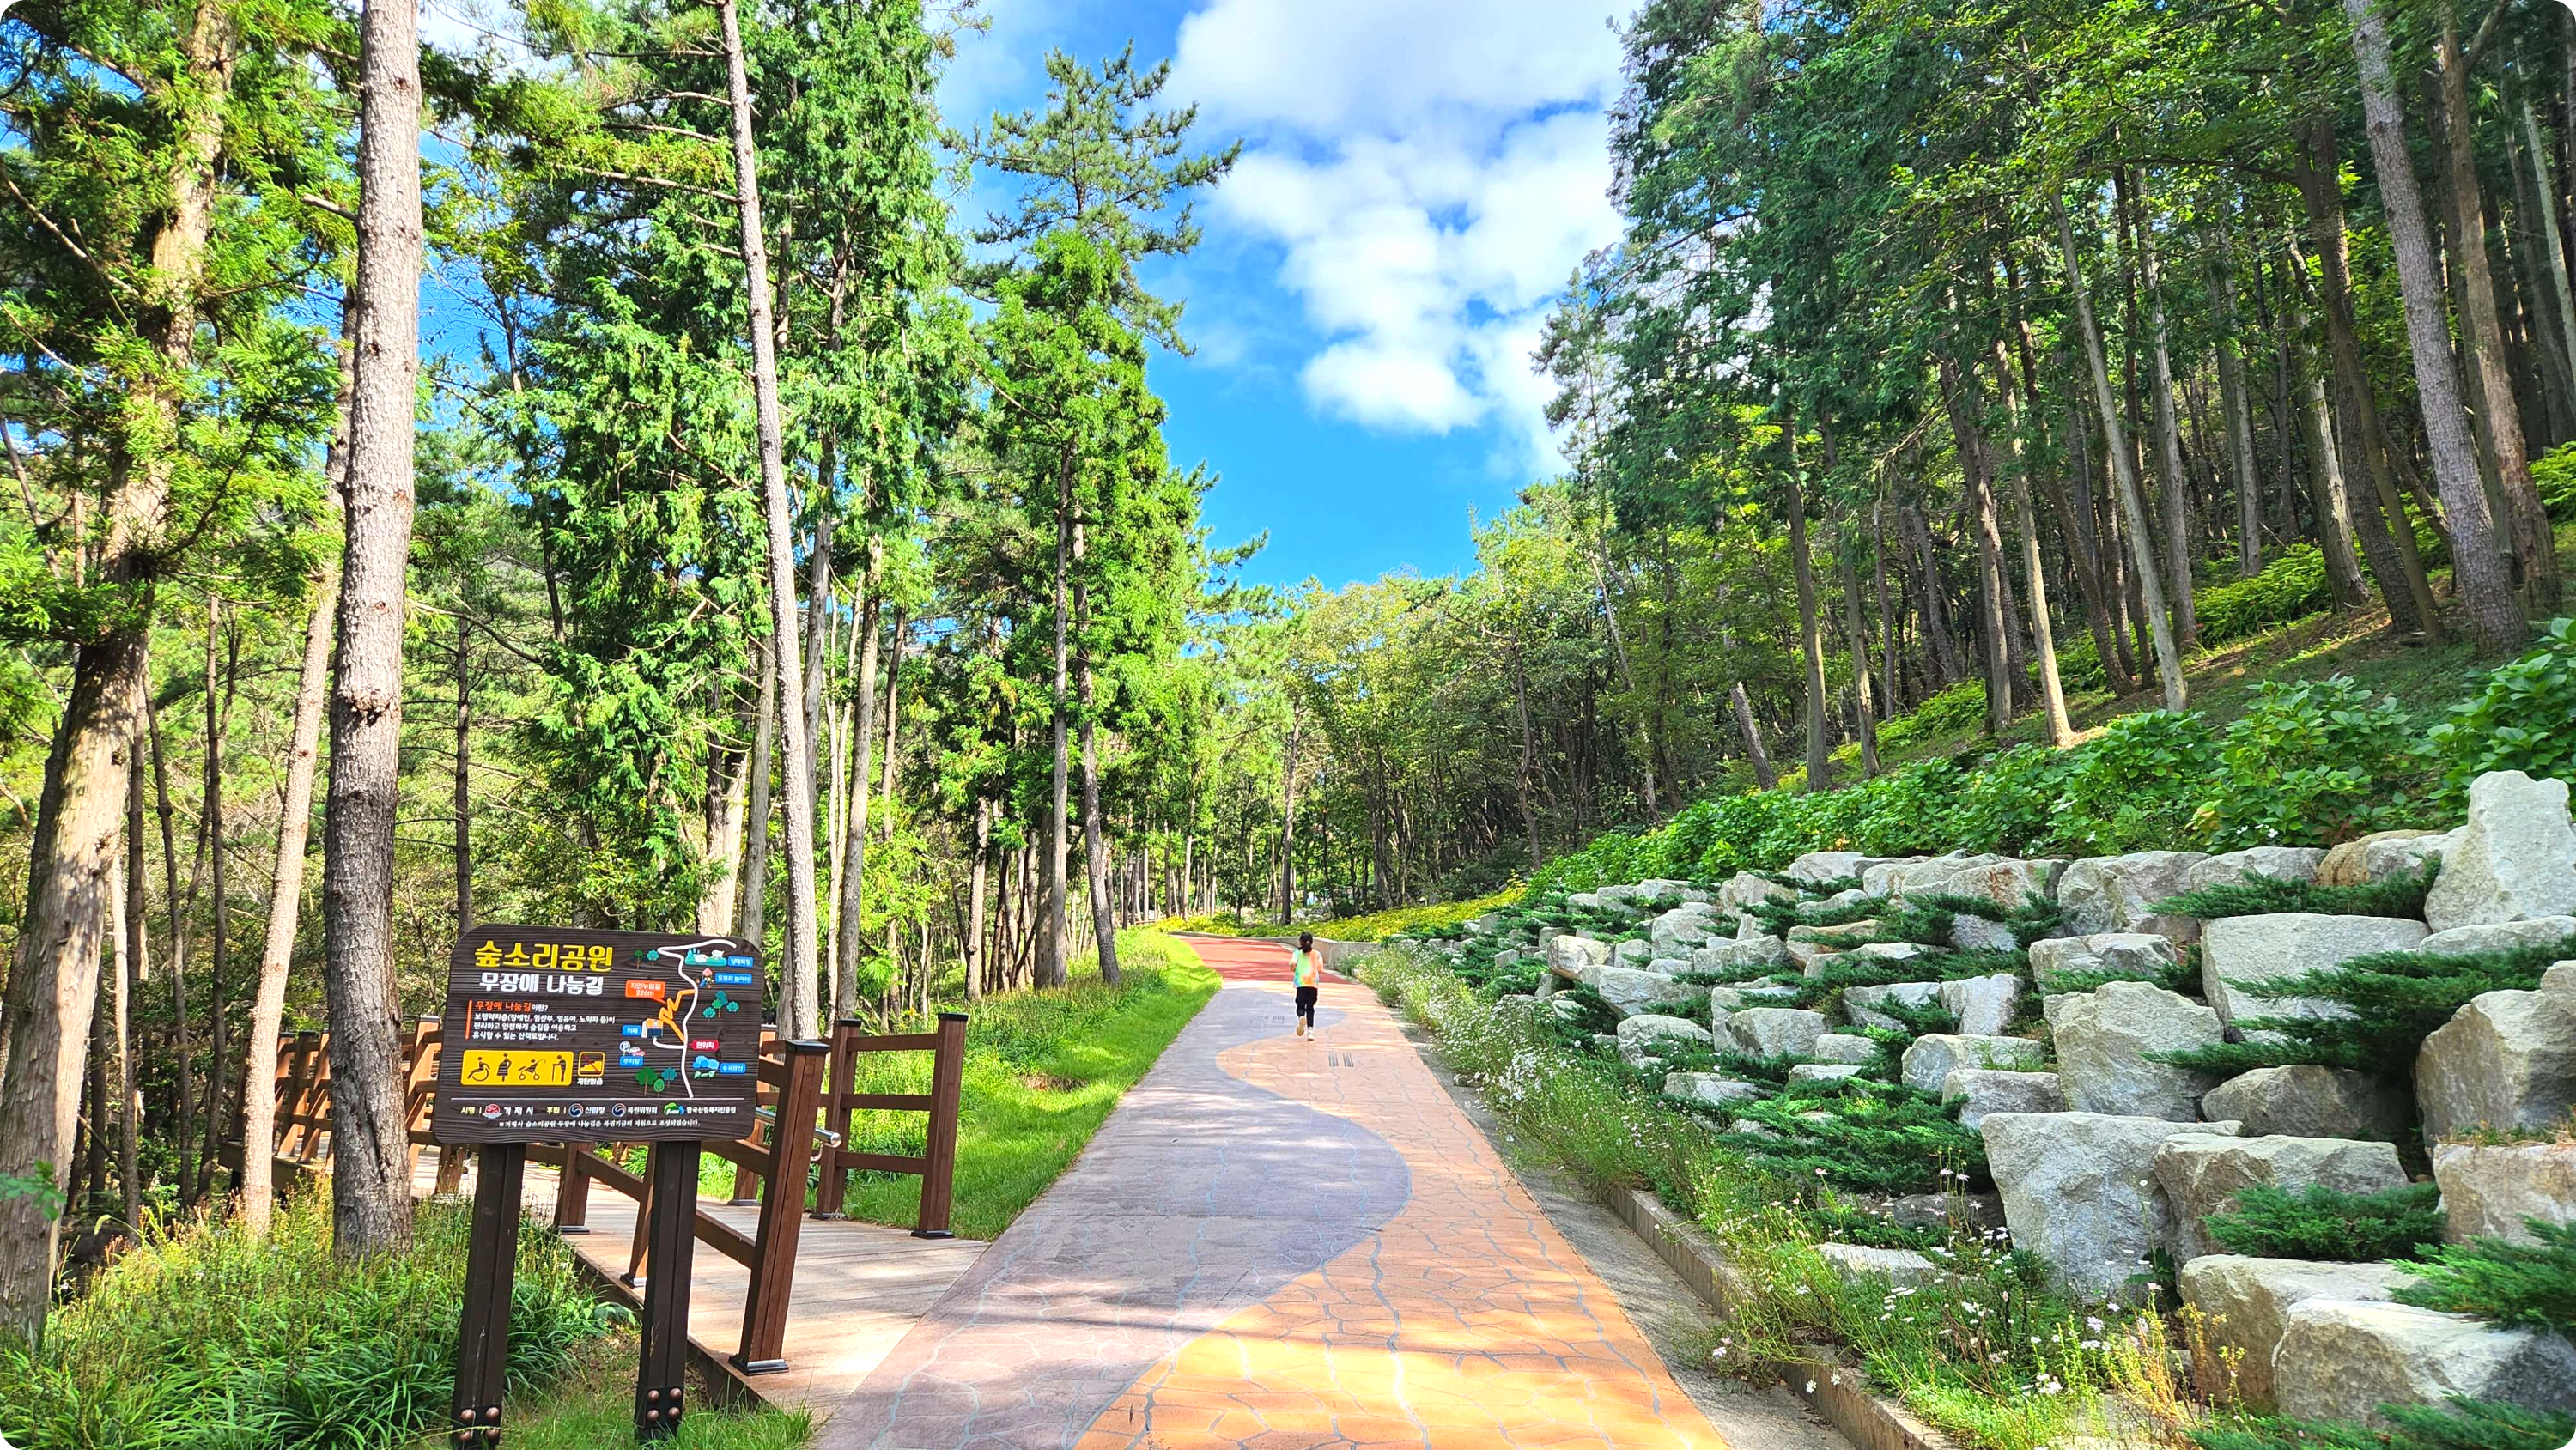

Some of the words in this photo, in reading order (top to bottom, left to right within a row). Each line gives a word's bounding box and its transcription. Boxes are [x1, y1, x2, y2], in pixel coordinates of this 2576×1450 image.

[475, 940, 614, 972] 숲소리공원
[479, 972, 540, 992] 무장애
[546, 975, 605, 996] 나눔길
[476, 1000, 503, 1010] 무장애
[472, 1031, 493, 1040] 휴식할
